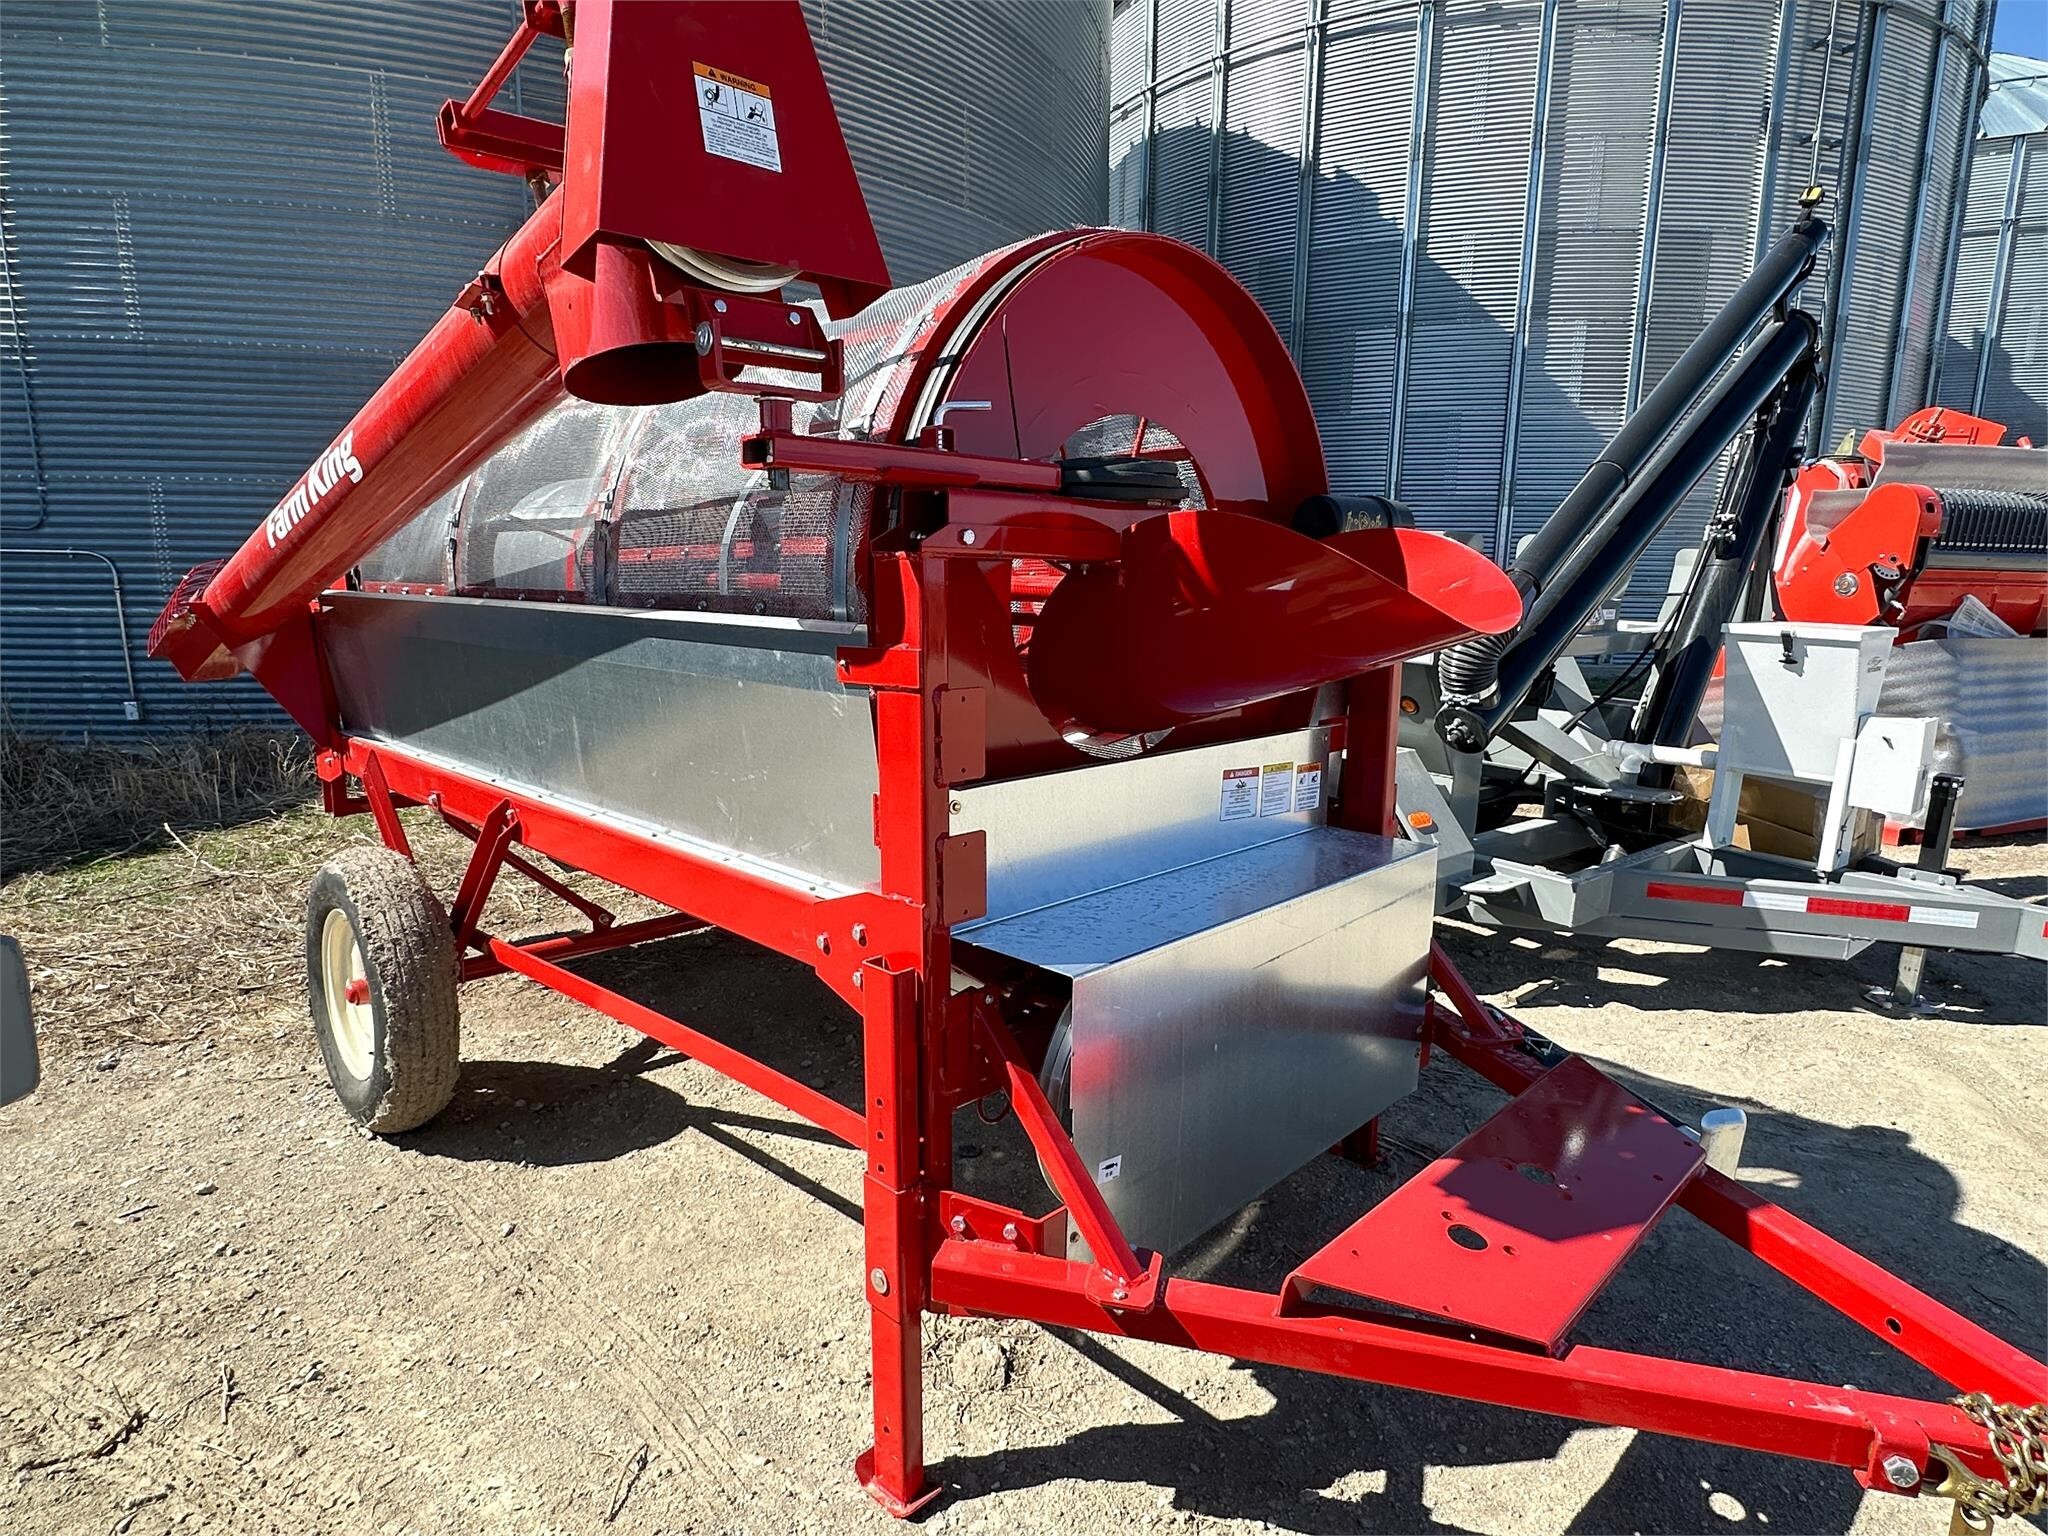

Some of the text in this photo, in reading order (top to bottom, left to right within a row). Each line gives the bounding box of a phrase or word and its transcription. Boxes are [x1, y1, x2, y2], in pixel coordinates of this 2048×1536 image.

[720, 73, 756, 92] WARNING
[266, 430, 364, 549] Farm King
